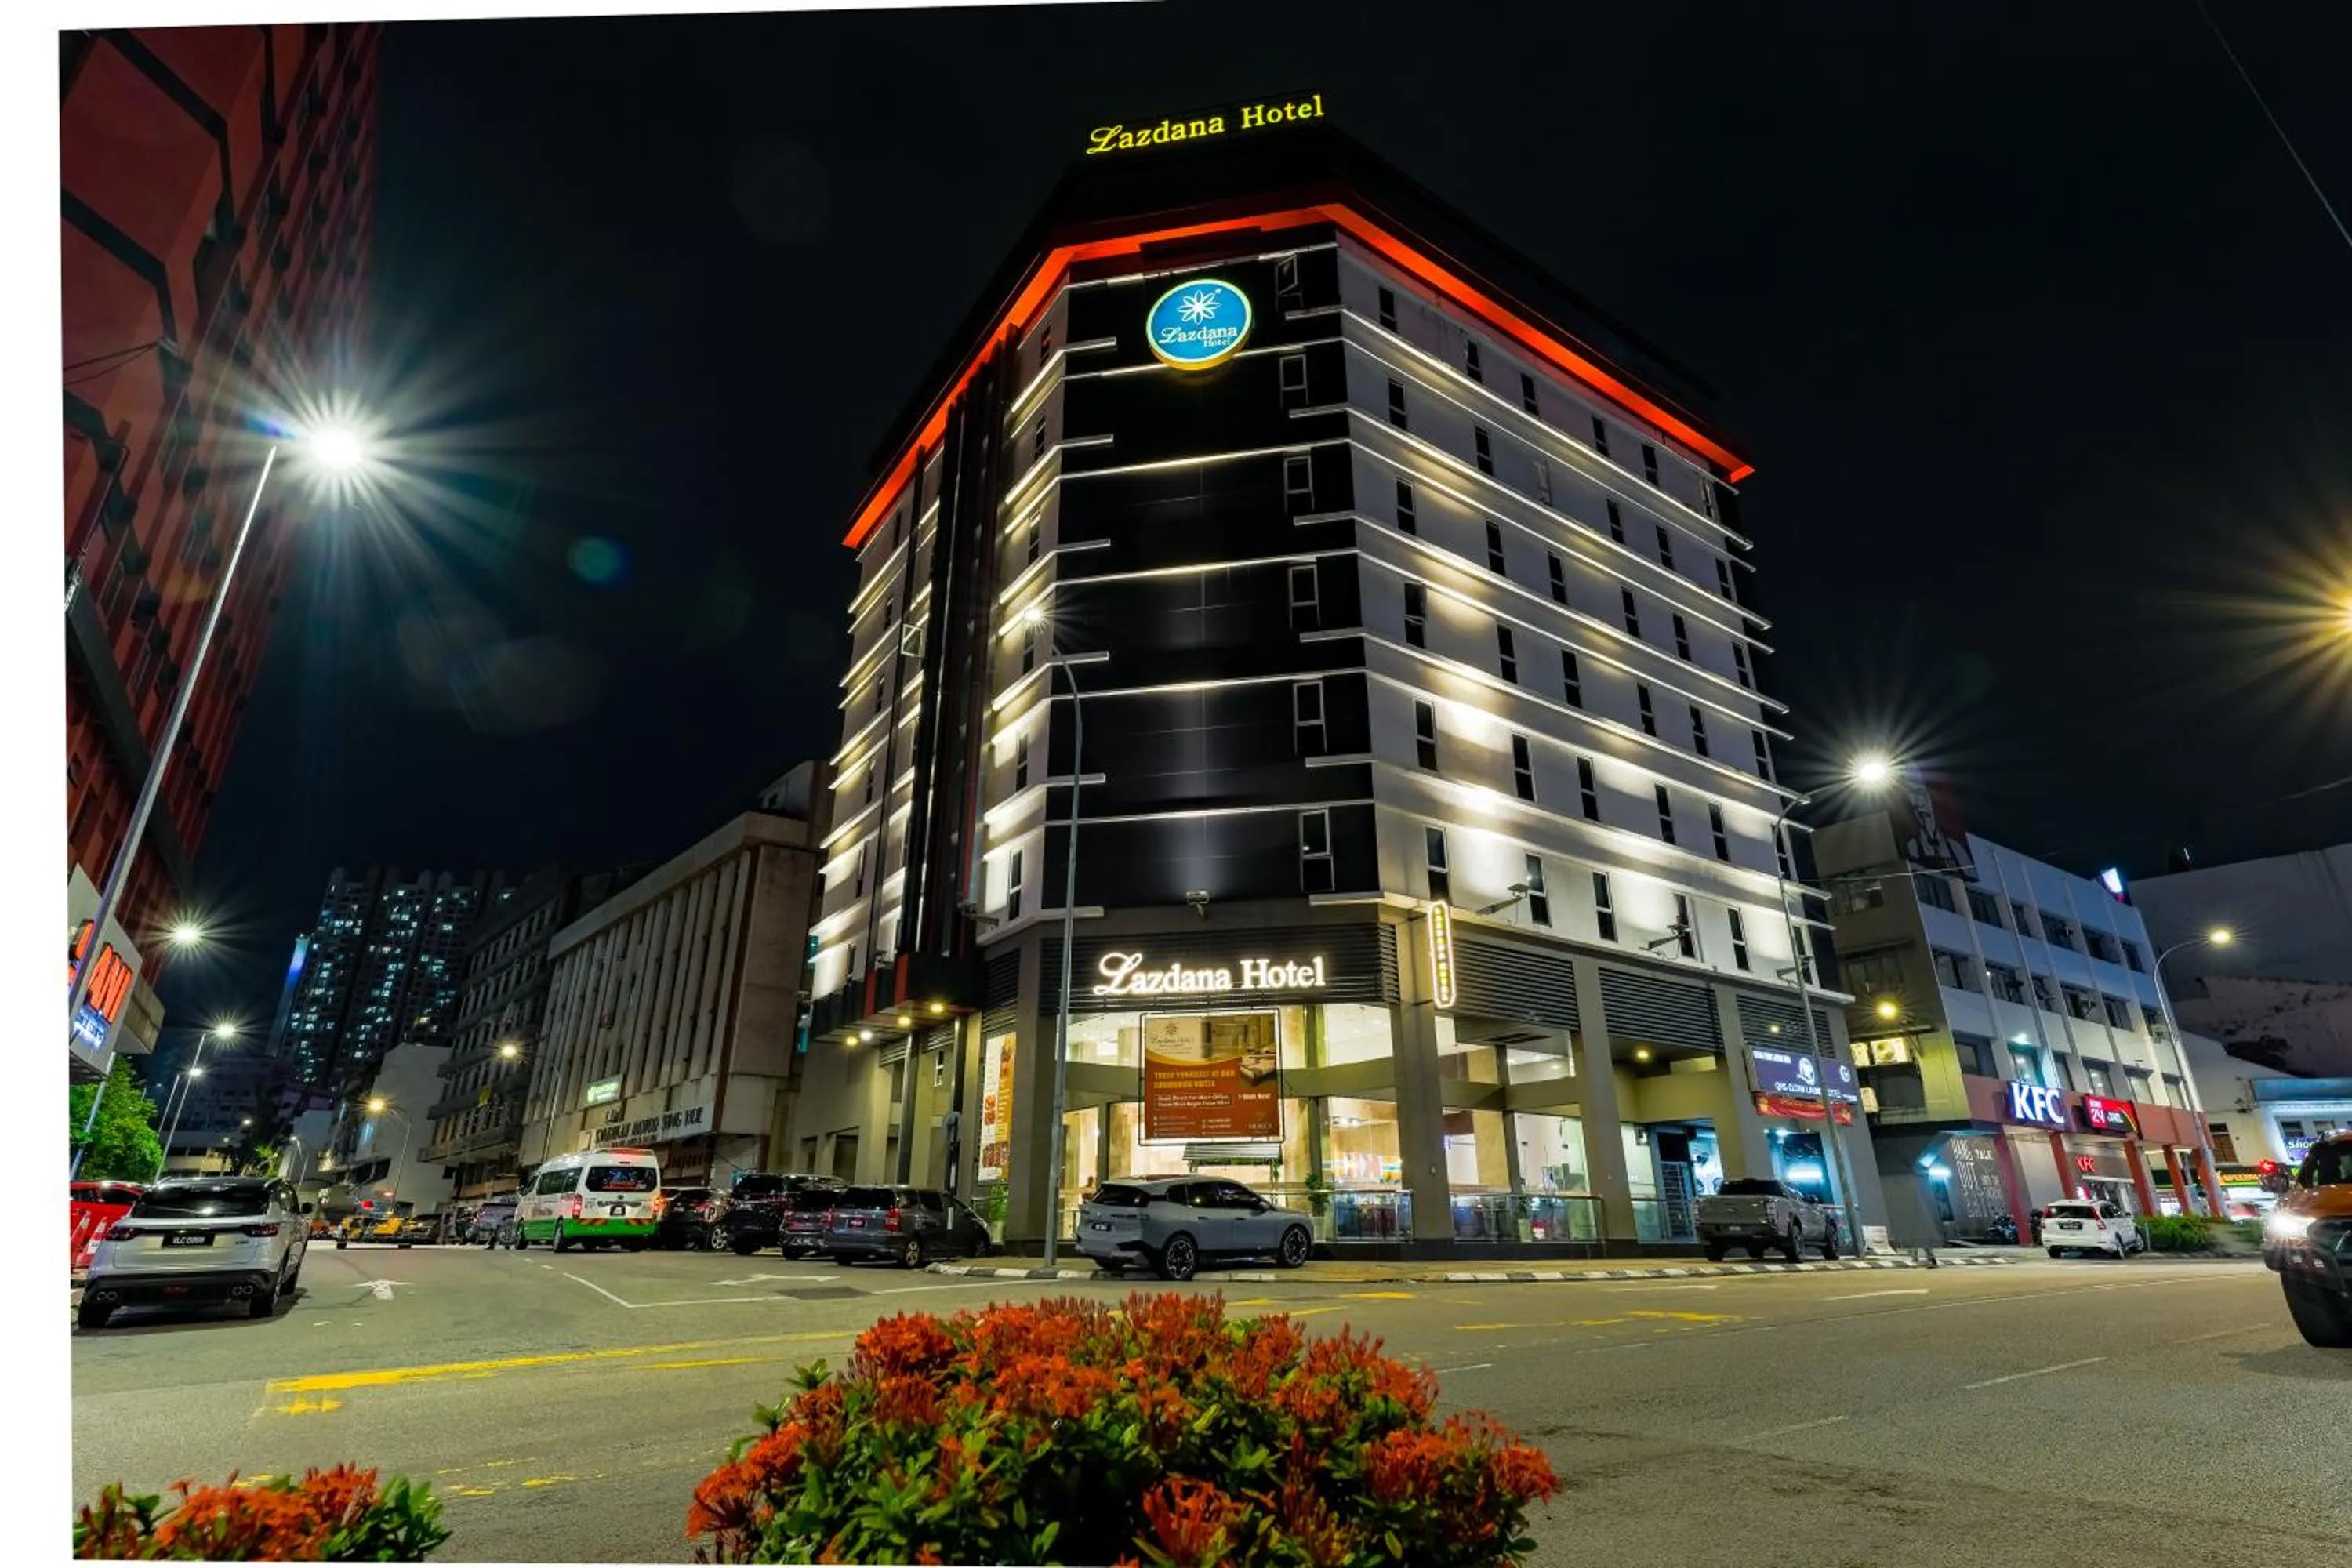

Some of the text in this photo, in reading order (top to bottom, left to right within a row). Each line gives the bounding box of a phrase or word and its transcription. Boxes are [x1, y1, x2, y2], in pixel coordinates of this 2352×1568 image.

[1086, 94, 1324, 154] Lazdana Hotel
[1159, 326, 1237, 344] Lazdana
[1203, 337, 1230, 347] Hotel
[1093, 952, 1326, 996] Lazdana Hotel
[2011, 1083, 2065, 1123] KFC
[2076, 1155, 2096, 1172] KFC
